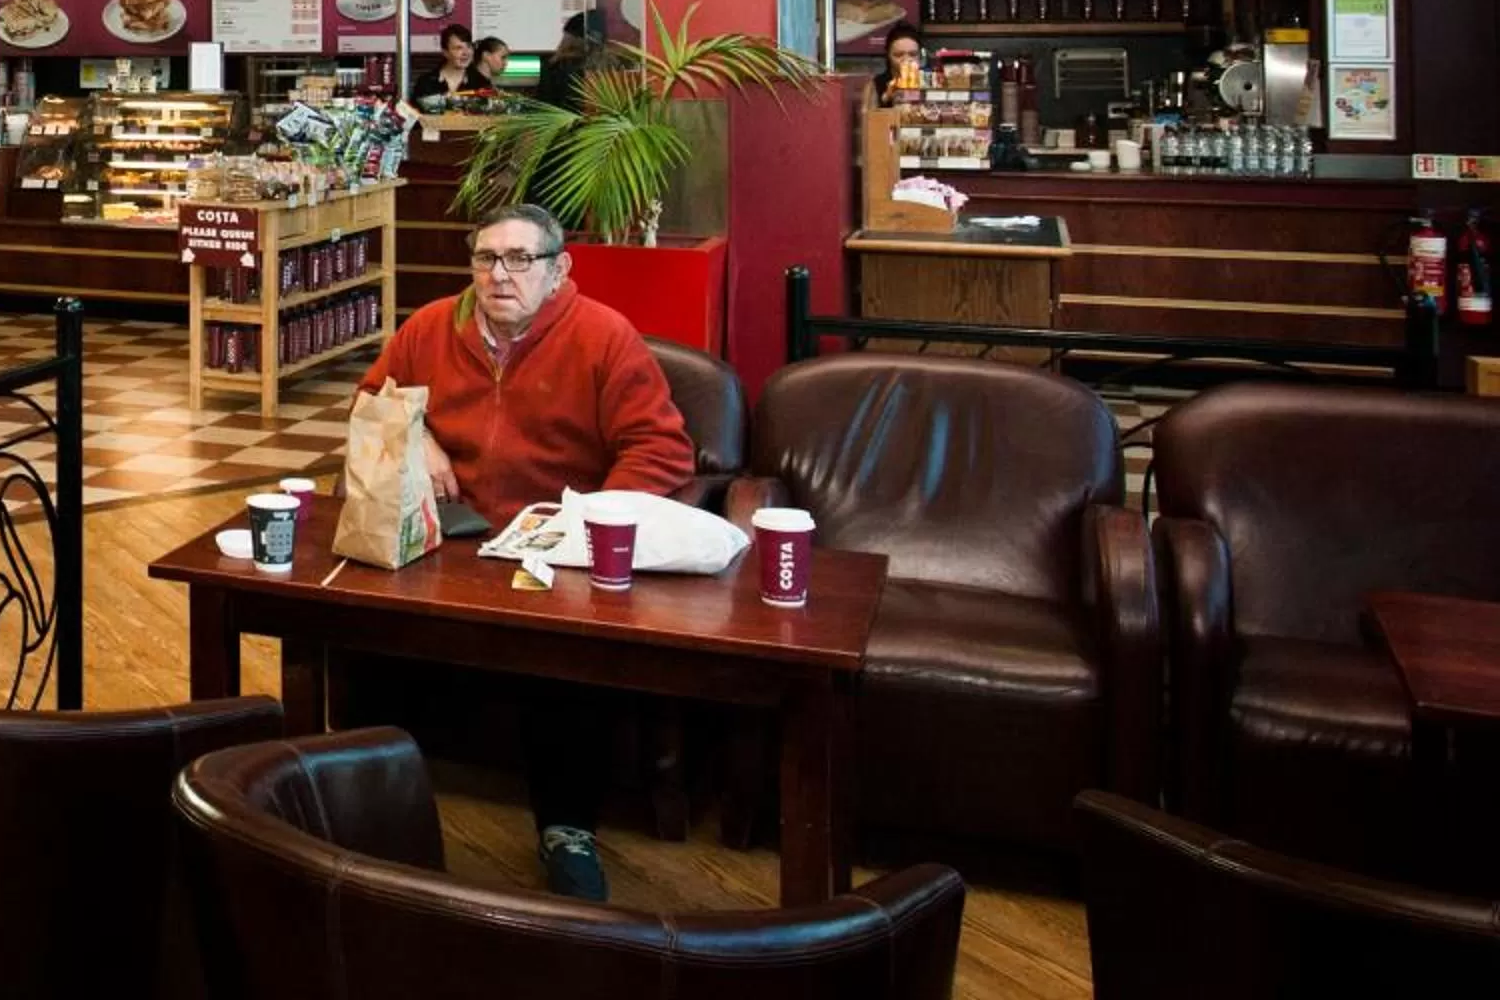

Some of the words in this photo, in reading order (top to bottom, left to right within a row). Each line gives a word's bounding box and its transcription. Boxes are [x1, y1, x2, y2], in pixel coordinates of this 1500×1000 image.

[197, 210, 239, 224] COSTA
[182, 226, 217, 237] PLEASE
[220, 229, 255, 240] QUEUE
[780, 541, 793, 590] COSTA
